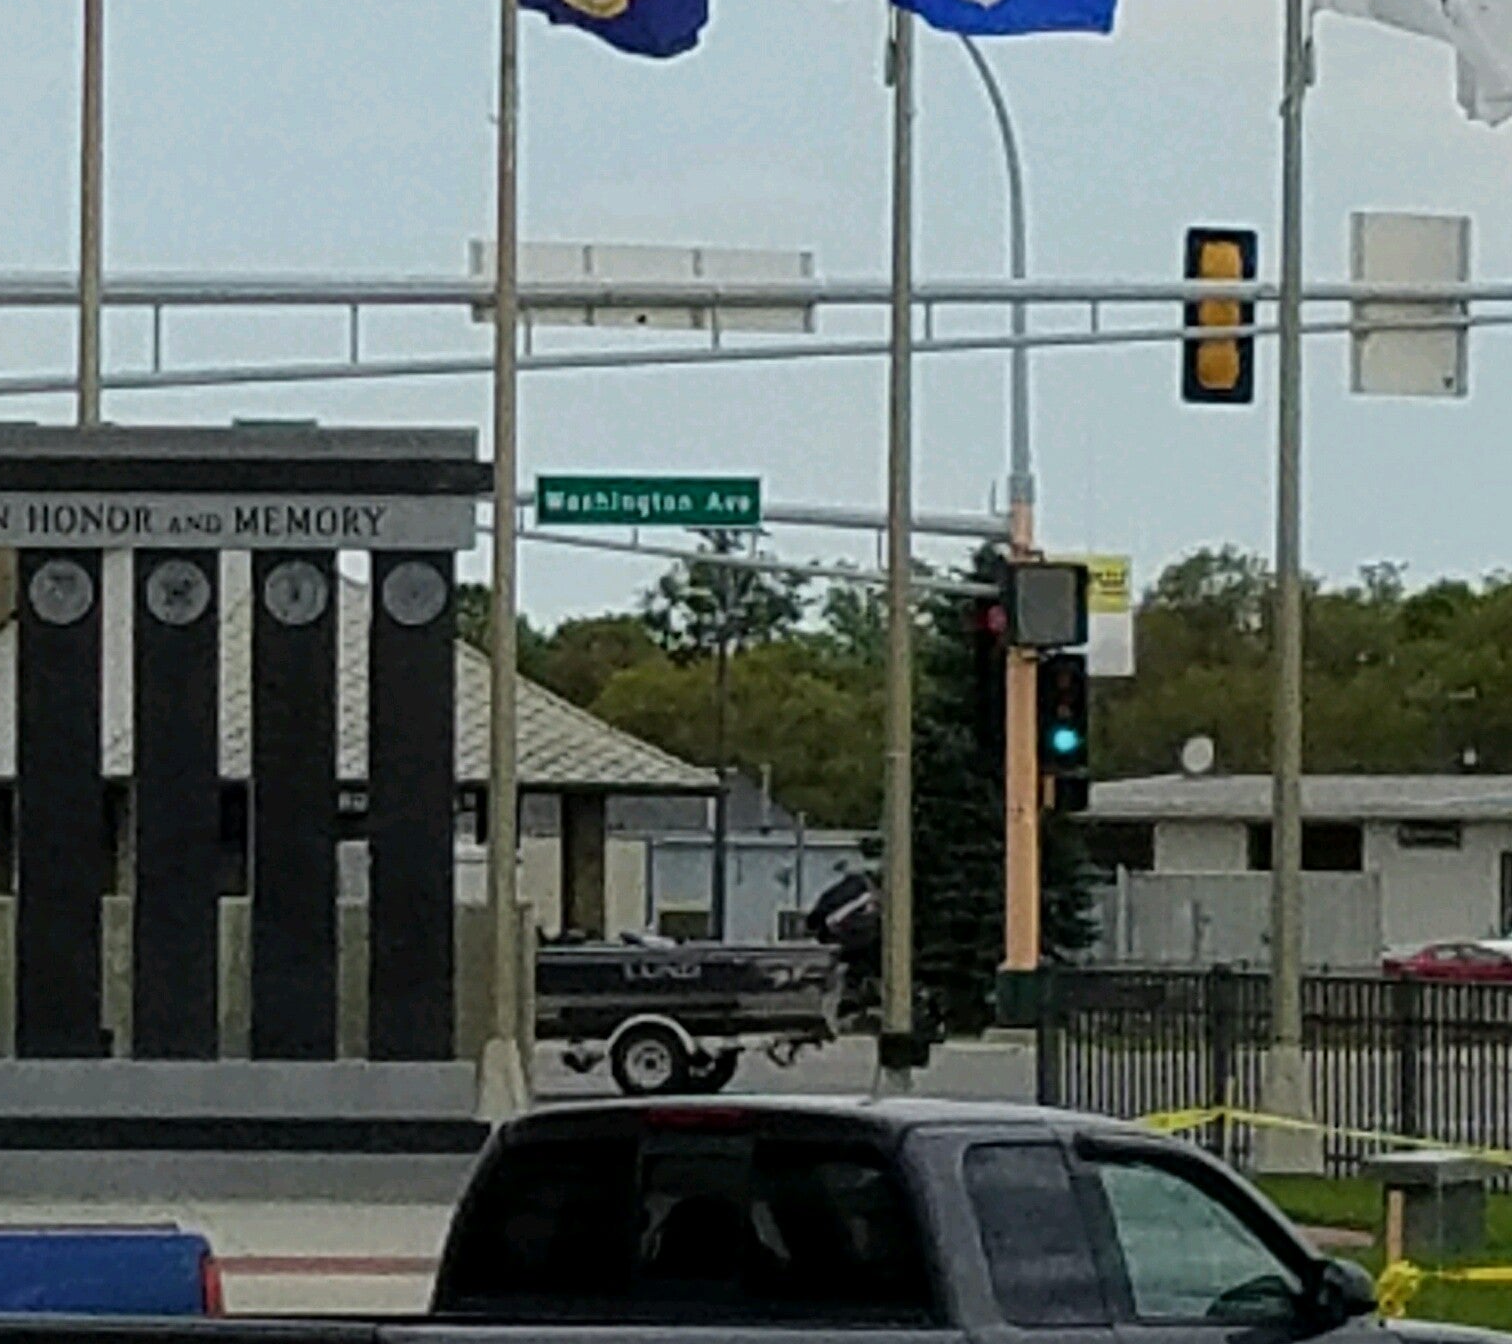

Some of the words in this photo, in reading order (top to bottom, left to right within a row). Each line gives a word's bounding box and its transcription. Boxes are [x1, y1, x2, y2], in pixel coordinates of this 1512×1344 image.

[544, 490, 693, 519] Washington
[706, 490, 751, 514] Ave
[28, 504, 153, 535] HONOR
[234, 504, 386, 536] MEMORY
